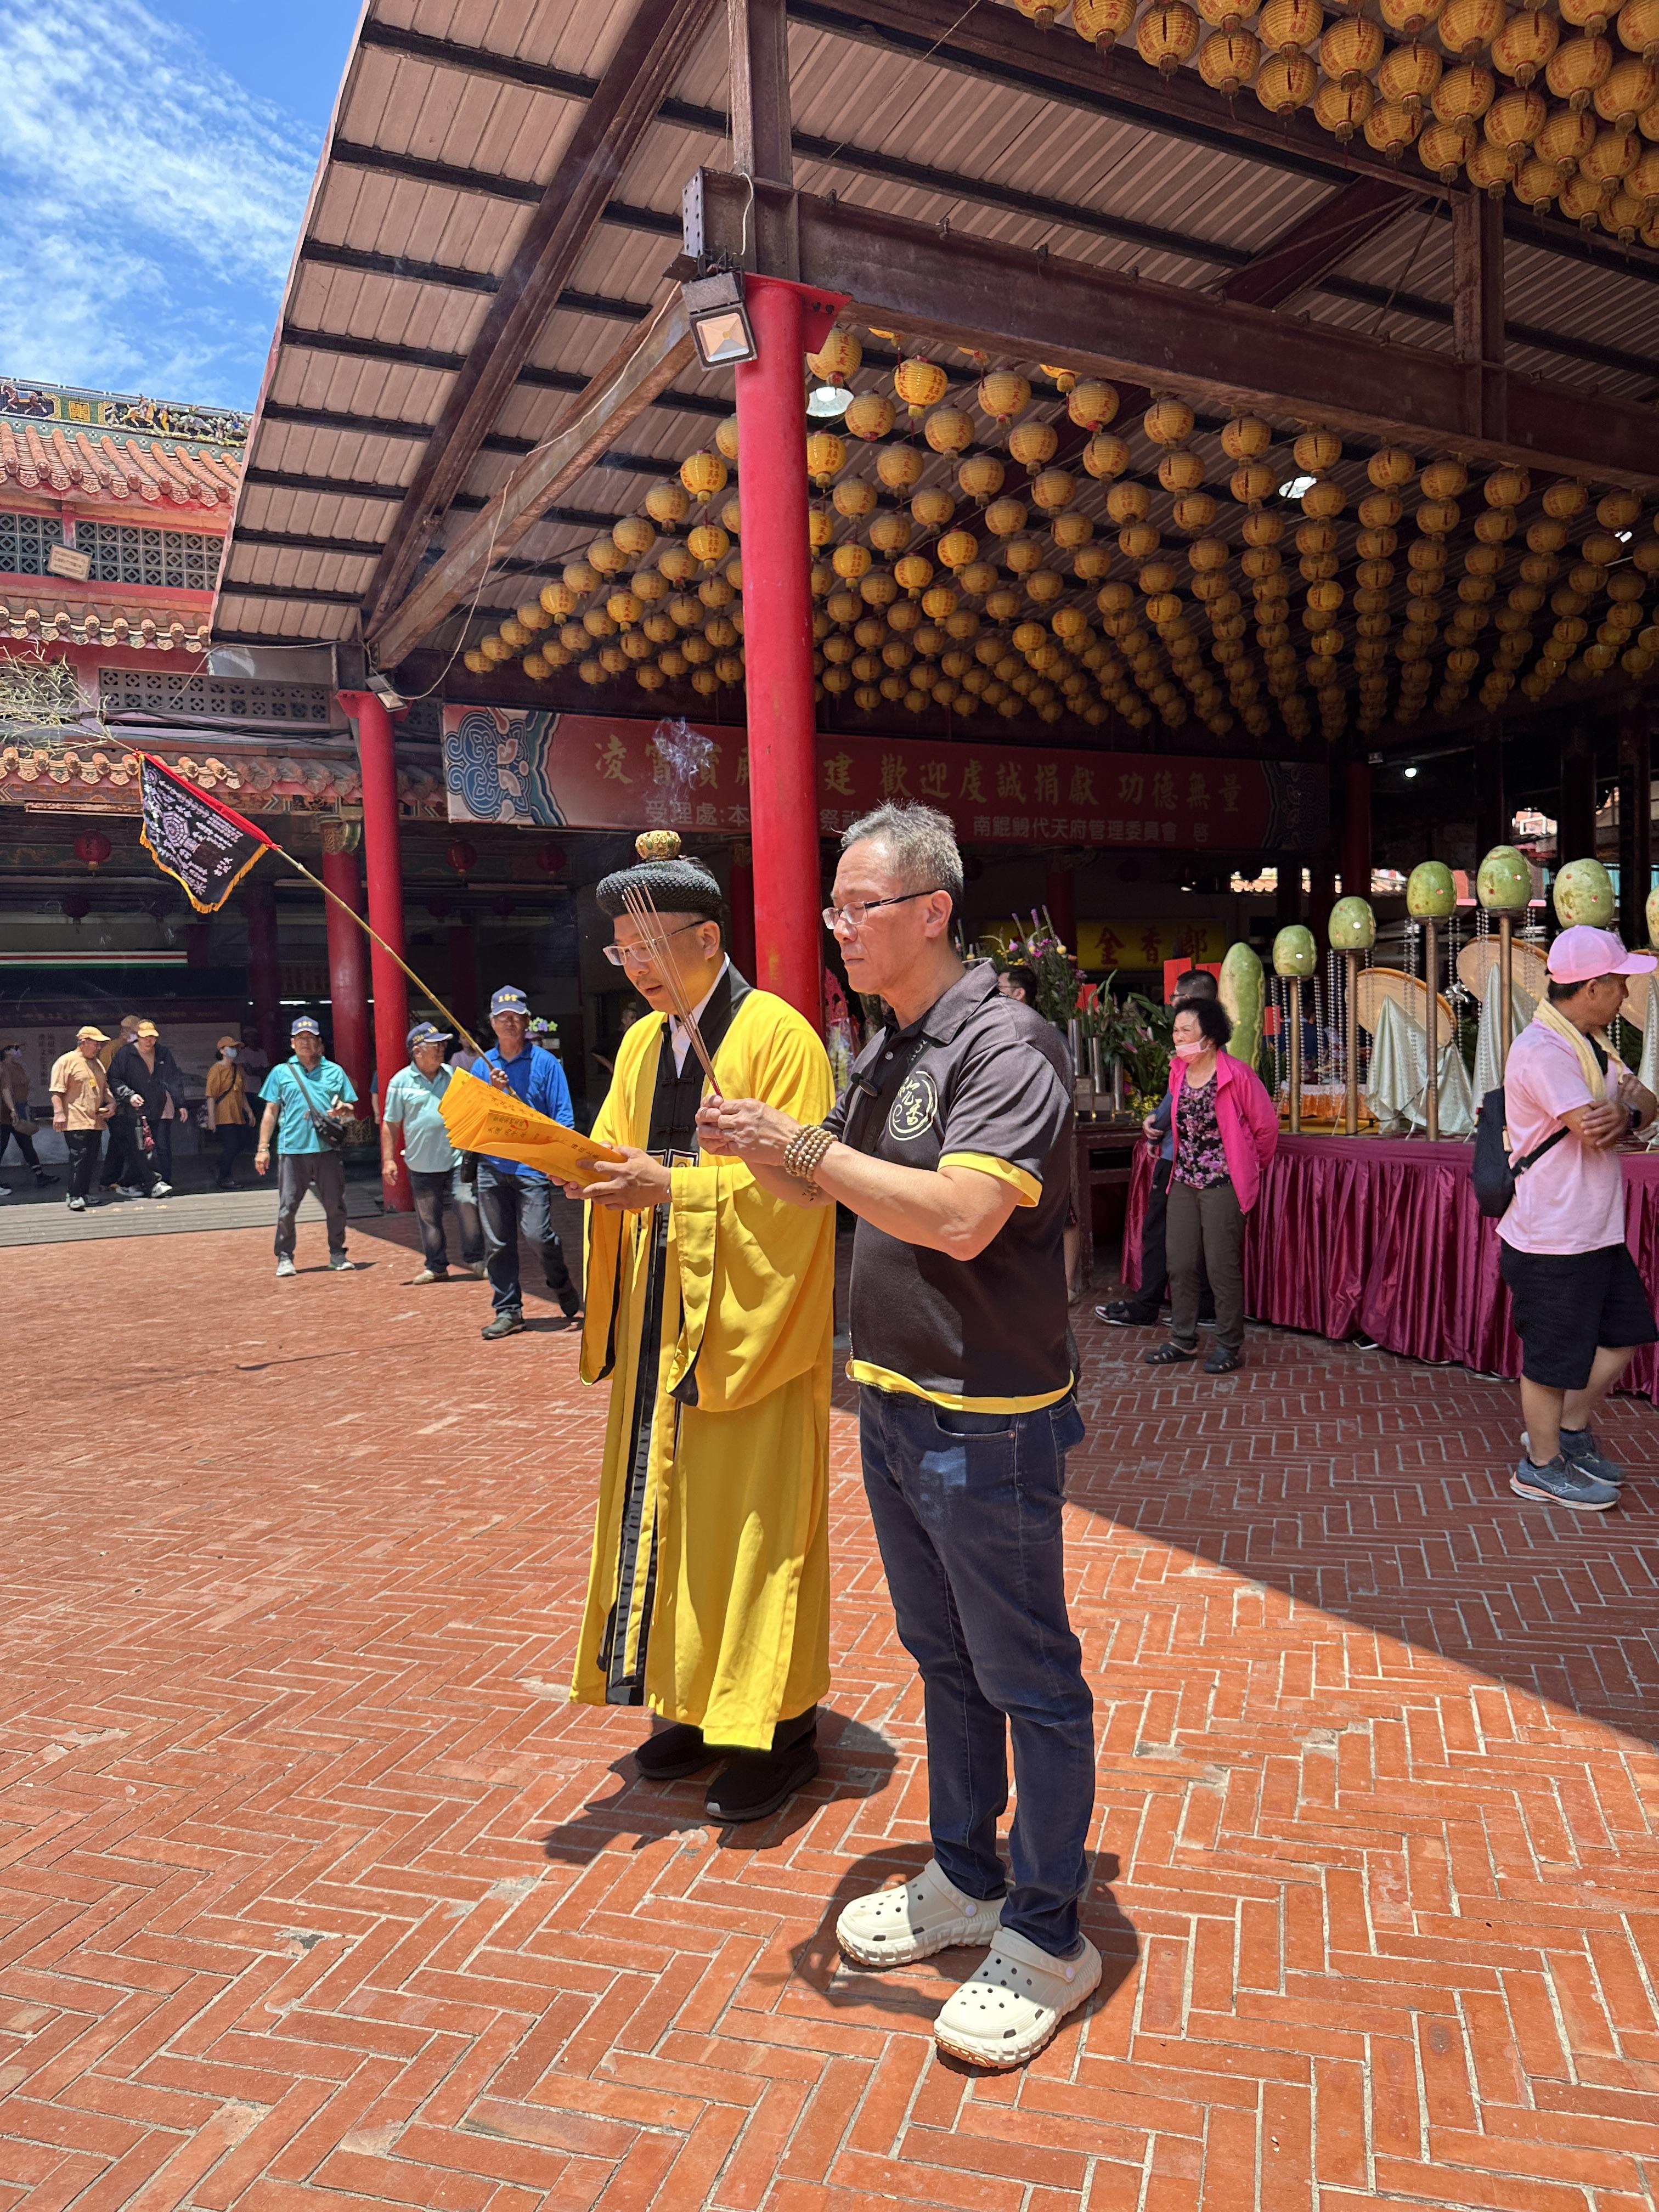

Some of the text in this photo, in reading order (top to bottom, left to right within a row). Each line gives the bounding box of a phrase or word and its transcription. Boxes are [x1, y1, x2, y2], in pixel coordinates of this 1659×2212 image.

[879, 753, 1099, 805] 歡迎虔誠捐獻
[1118, 770, 1242, 812] 功德無量
